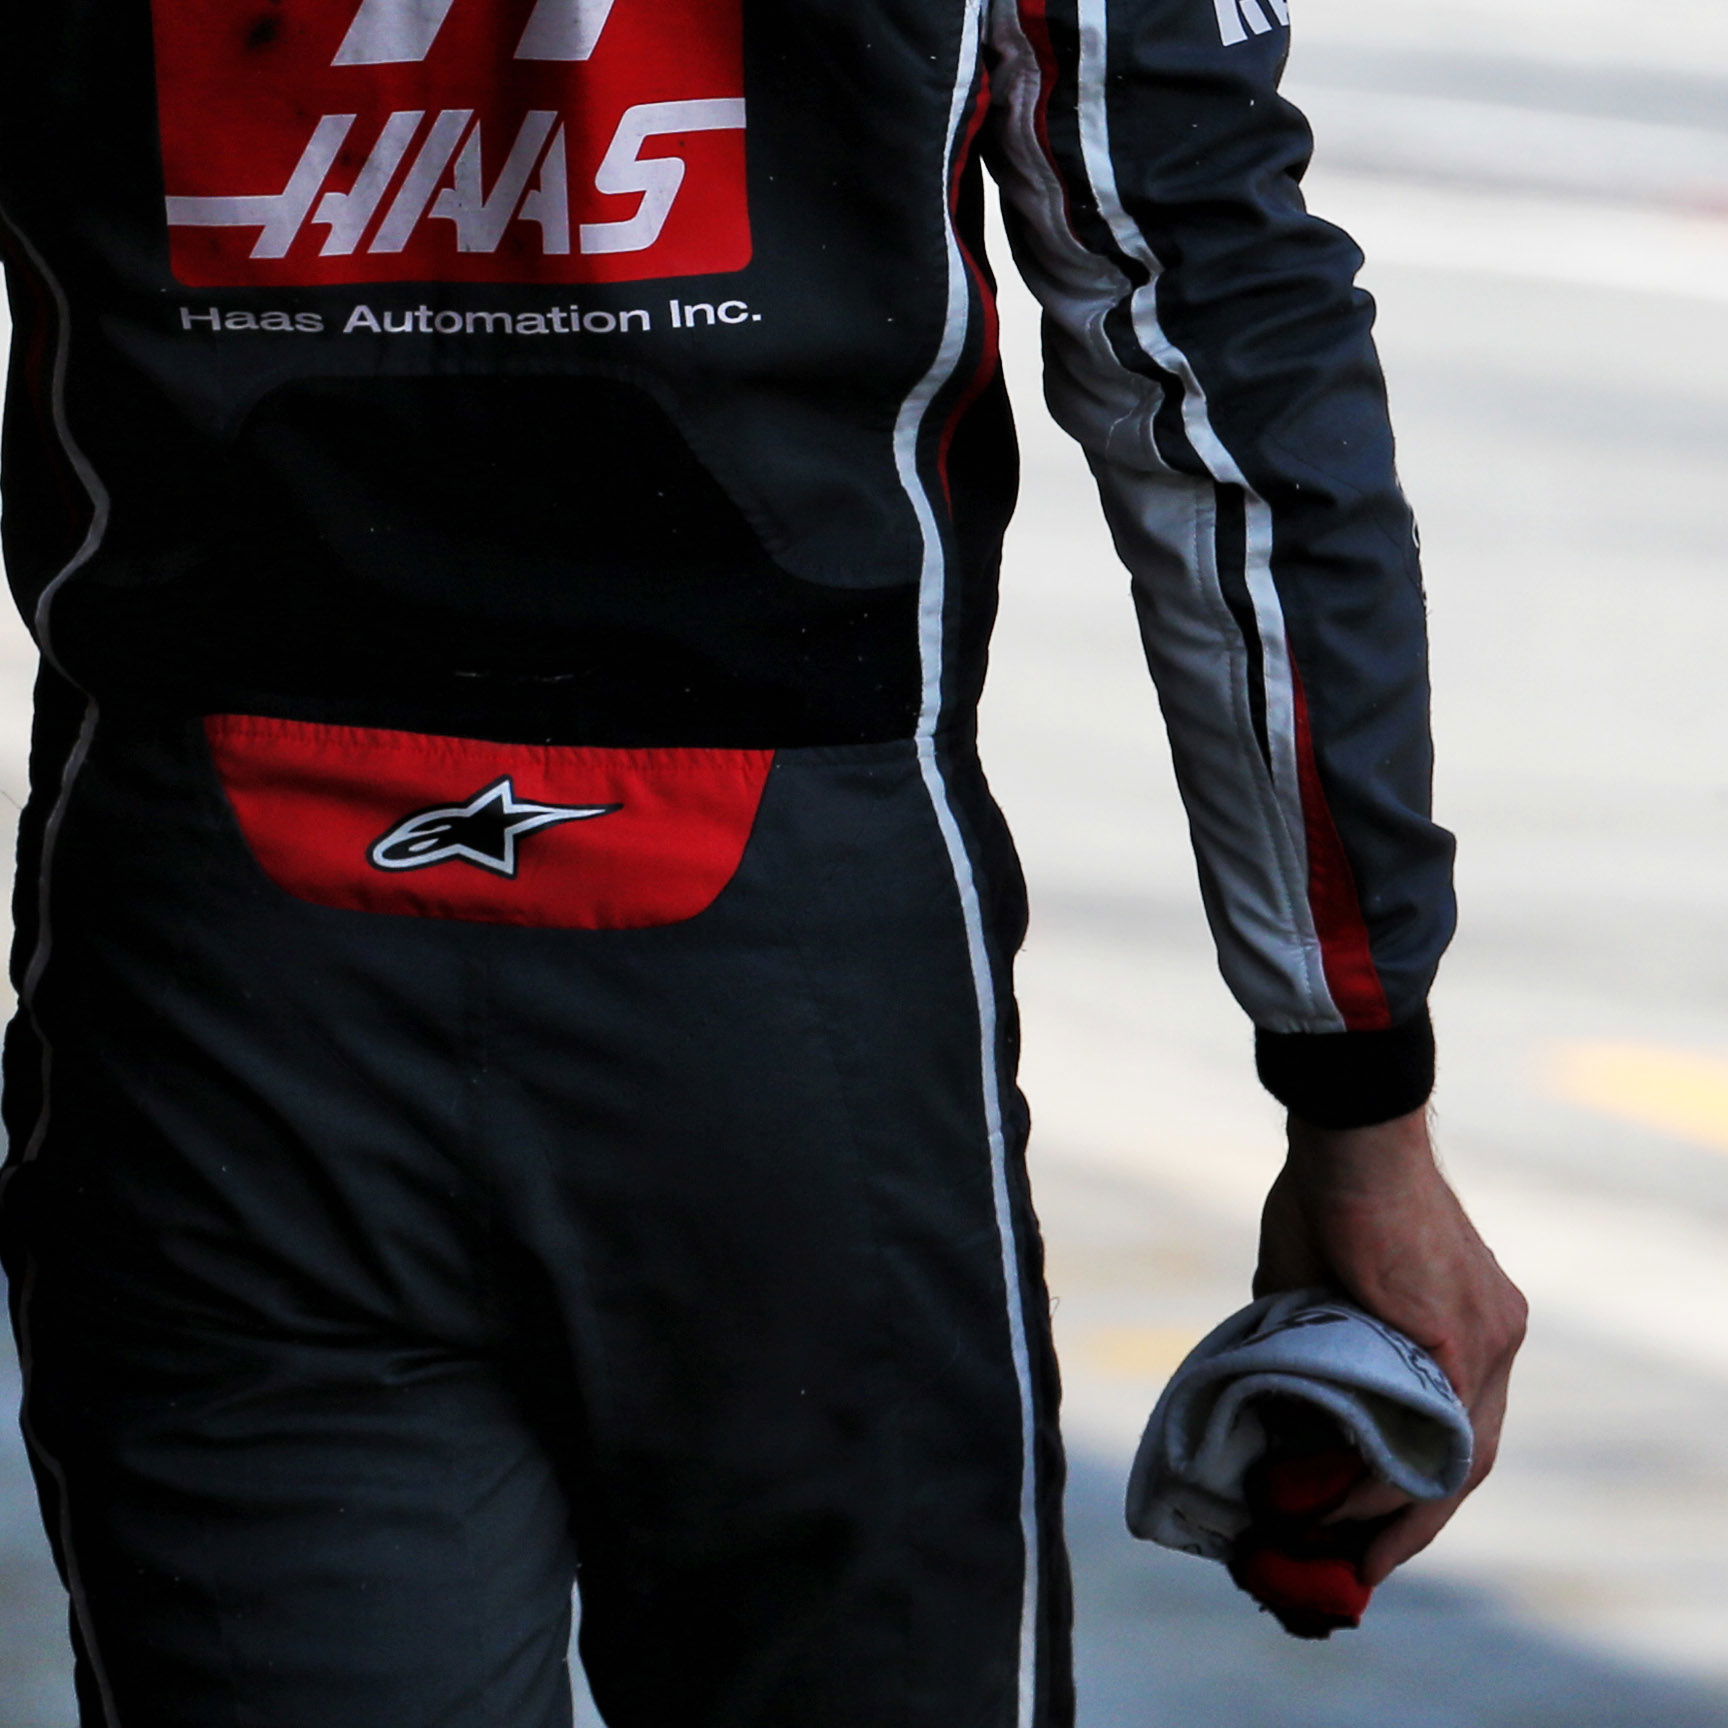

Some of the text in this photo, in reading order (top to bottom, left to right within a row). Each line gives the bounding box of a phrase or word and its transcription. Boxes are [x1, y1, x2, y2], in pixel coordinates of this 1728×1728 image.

[165, 97, 746, 259] HAAS
[180, 299, 764, 335] Haas Automation Inc.
